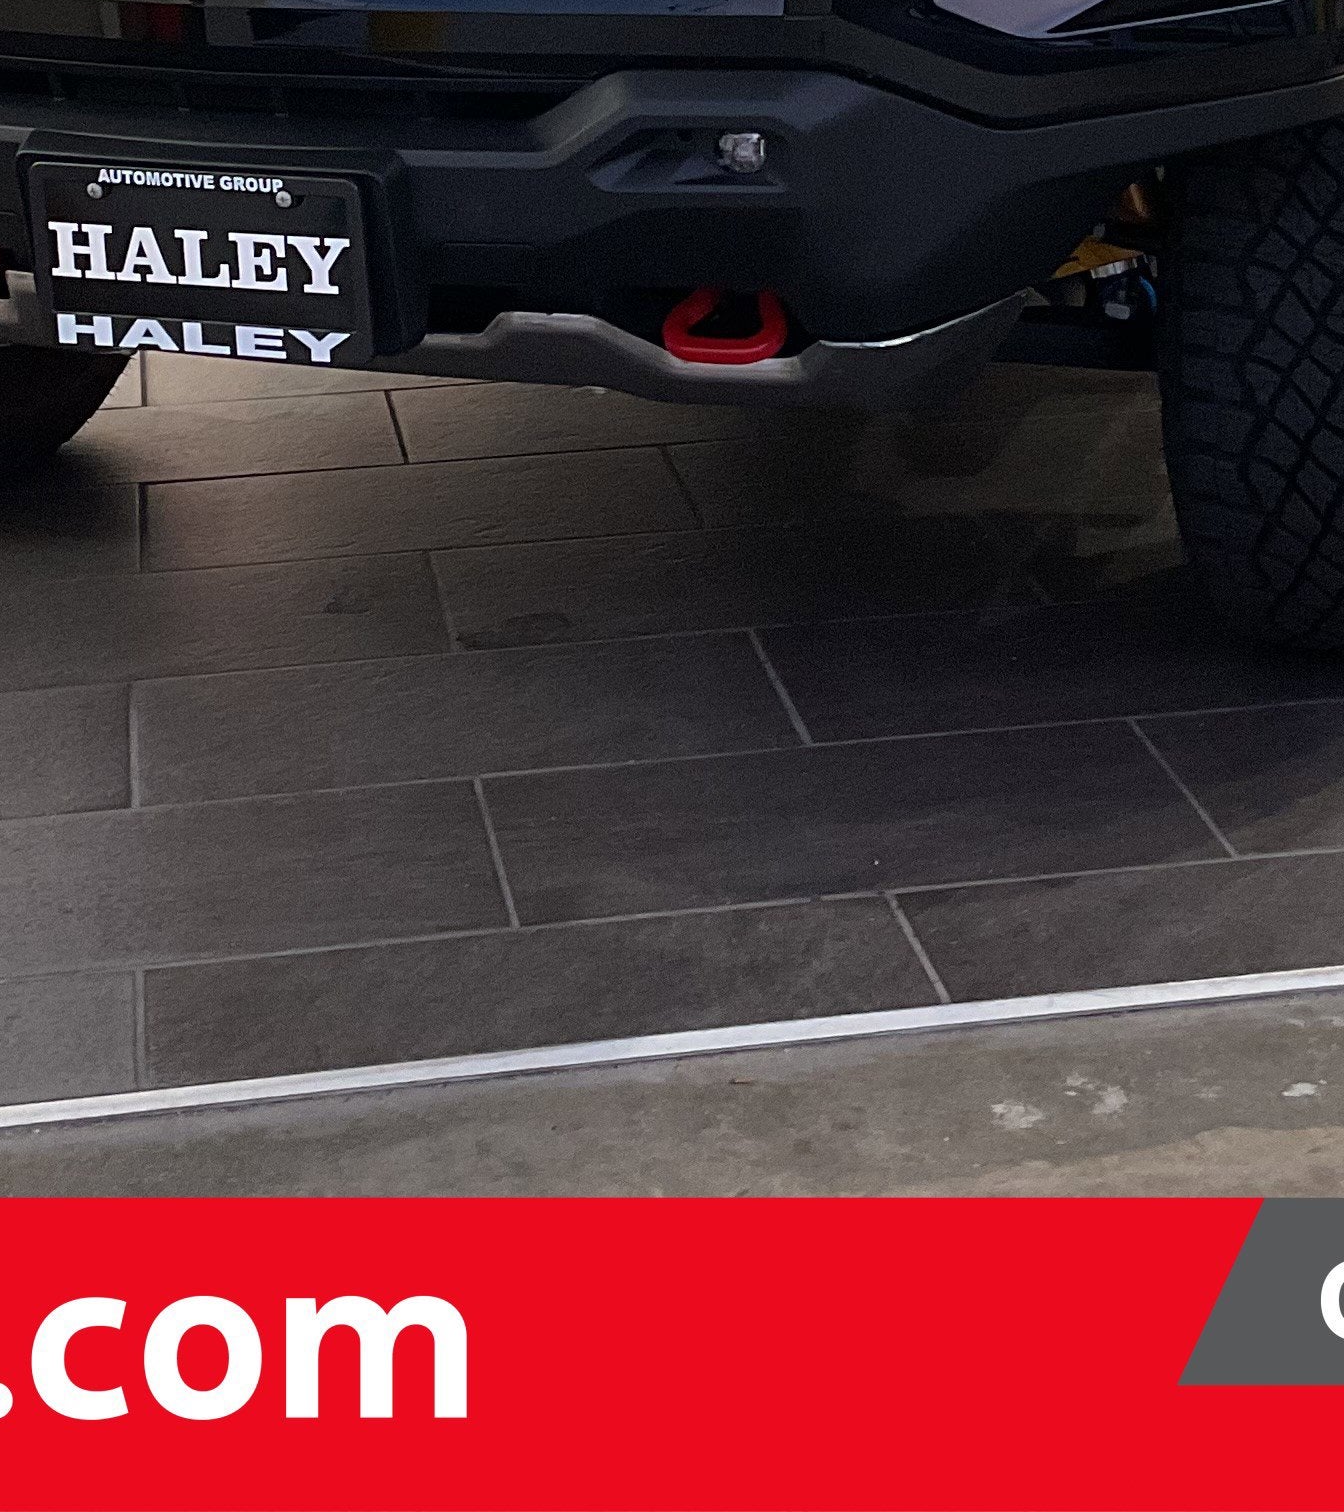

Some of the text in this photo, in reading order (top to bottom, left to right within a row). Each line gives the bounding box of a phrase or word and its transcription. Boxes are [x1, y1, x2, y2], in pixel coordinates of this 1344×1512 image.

[97, 168, 284, 195] AUTOMOTIVE GROUP
[47, 220, 351, 295] HALEY
[56, 313, 352, 364] HALEY
